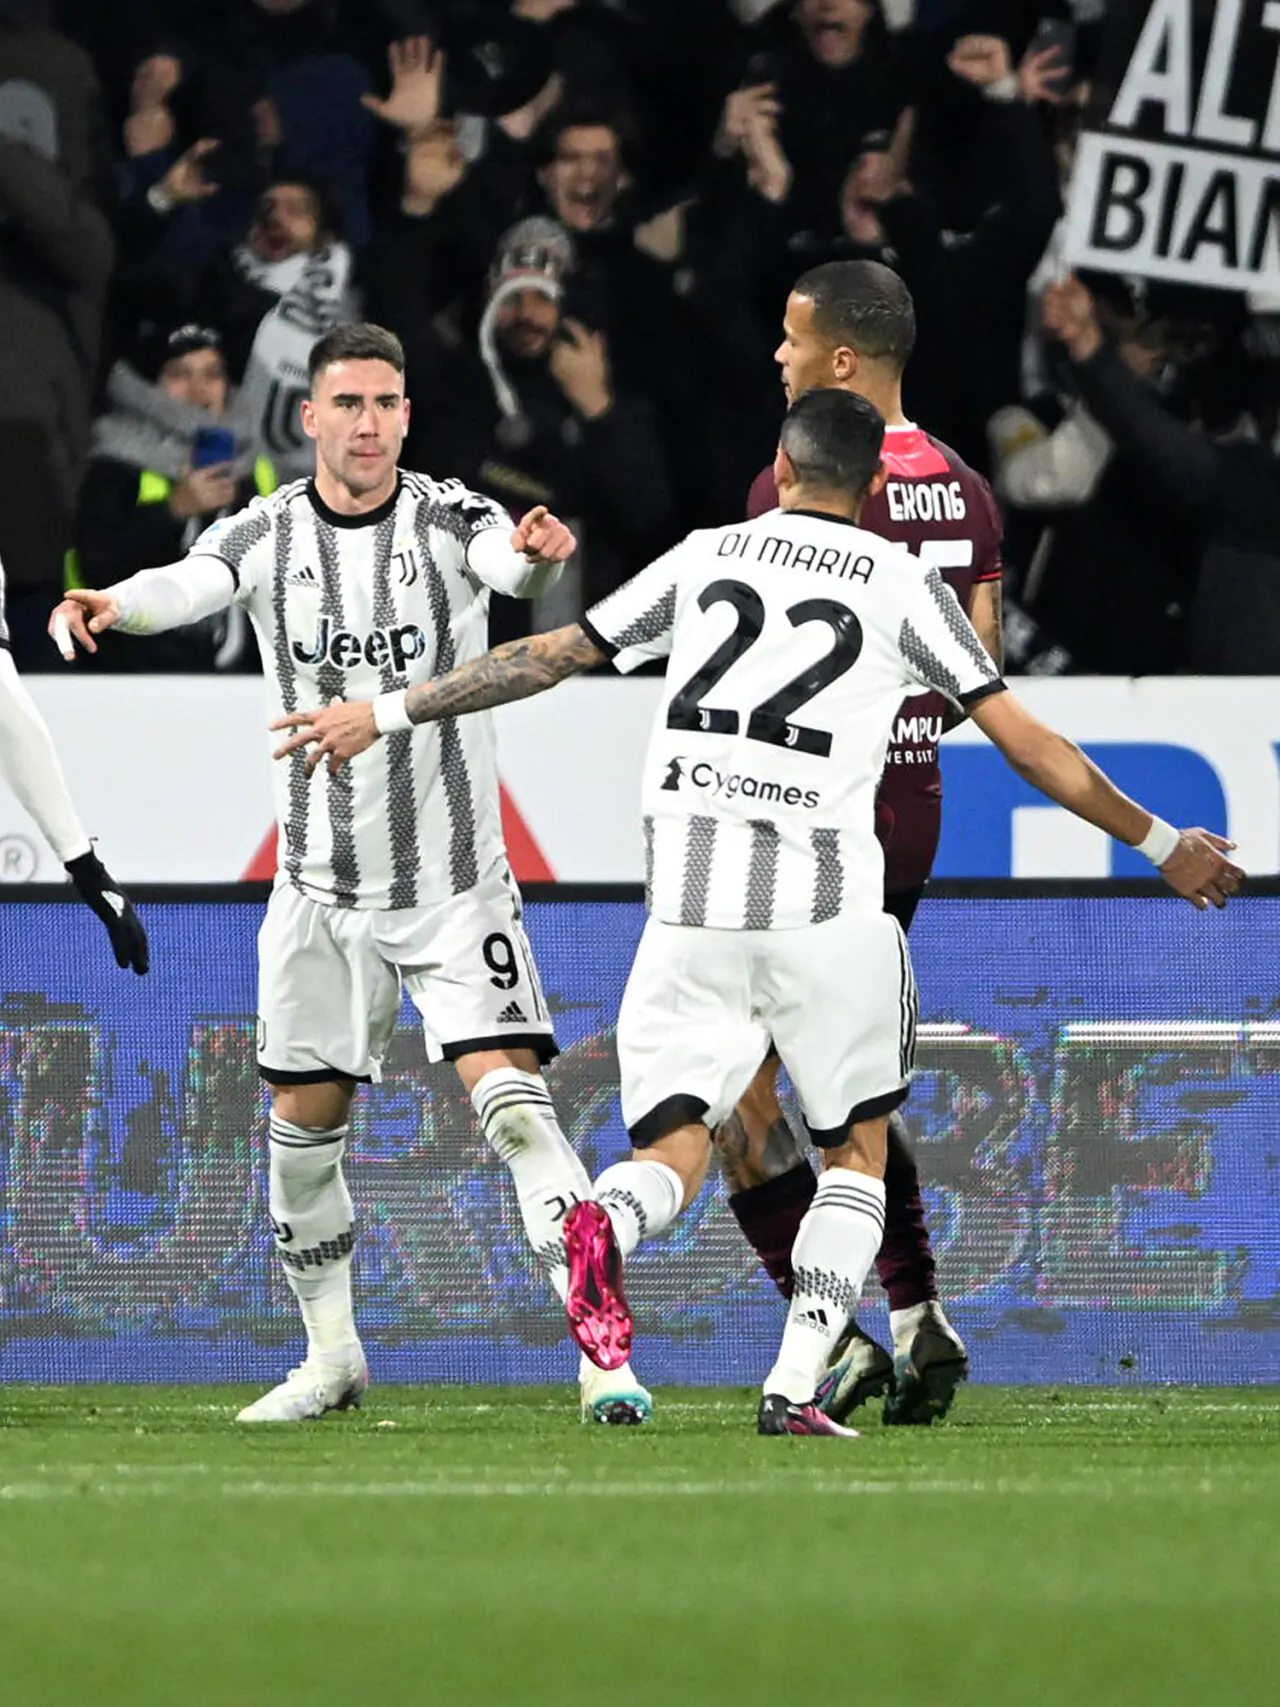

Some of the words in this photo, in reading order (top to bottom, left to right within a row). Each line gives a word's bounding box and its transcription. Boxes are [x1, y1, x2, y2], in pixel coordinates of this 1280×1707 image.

[887, 481, 966, 521] EKONG
[717, 533, 752, 558] DI
[757, 536, 875, 585] MARIA
[292, 618, 426, 673] Jeep
[666, 579, 864, 758] 22
[889, 716, 943, 744] MPU
[691, 763, 821, 809] Cygames
[482, 932, 519, 990] 9
